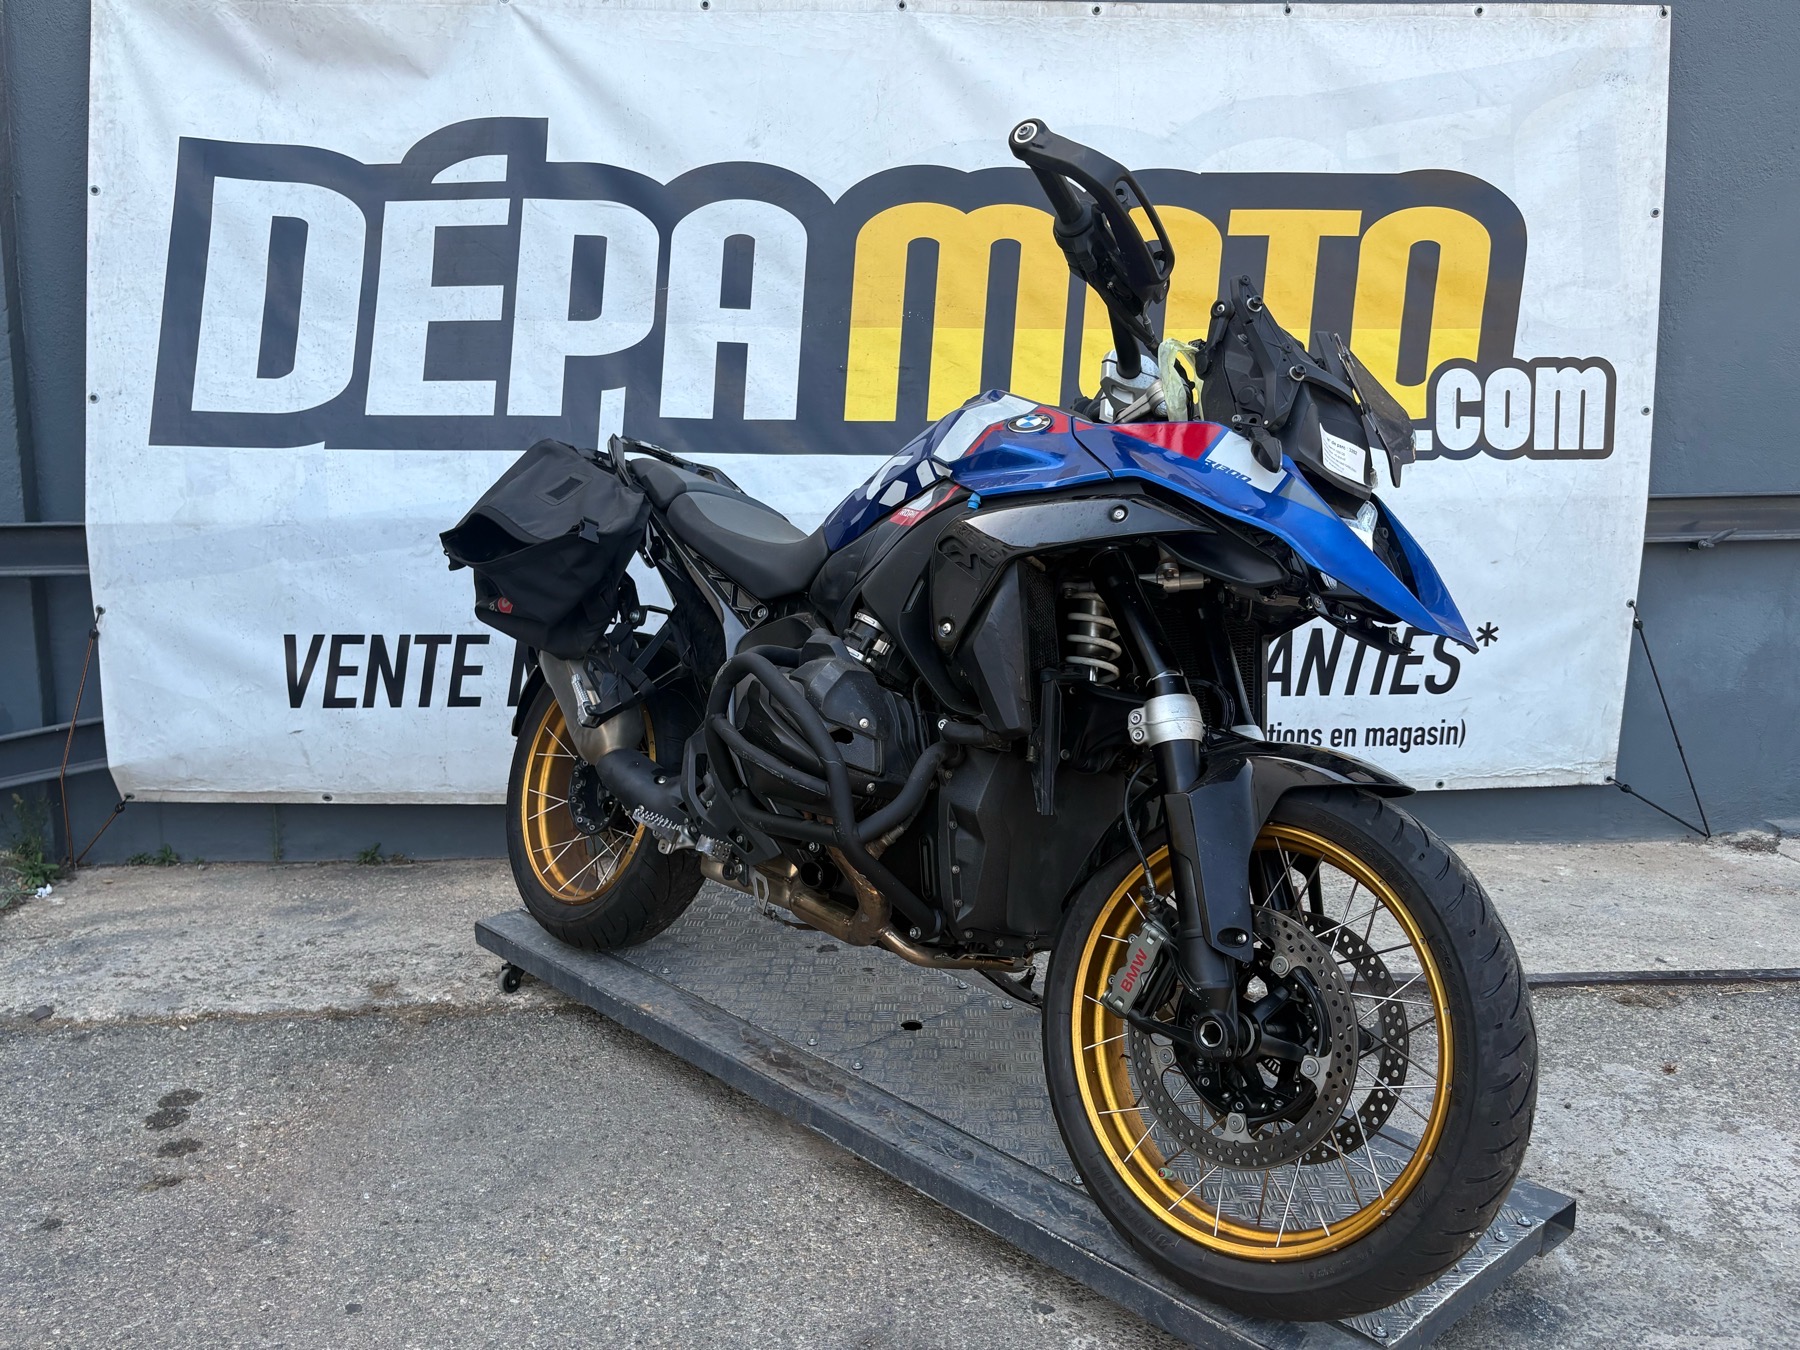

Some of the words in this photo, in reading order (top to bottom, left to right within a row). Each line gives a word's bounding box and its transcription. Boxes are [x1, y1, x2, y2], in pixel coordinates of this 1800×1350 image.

[283, 634, 490, 708] VENTE
[1267, 722, 1323, 747] tions
[1330, 729, 1357, 747] en
[1364, 718, 1467, 753] magasin)
[1120, 948, 1148, 993] BMW
